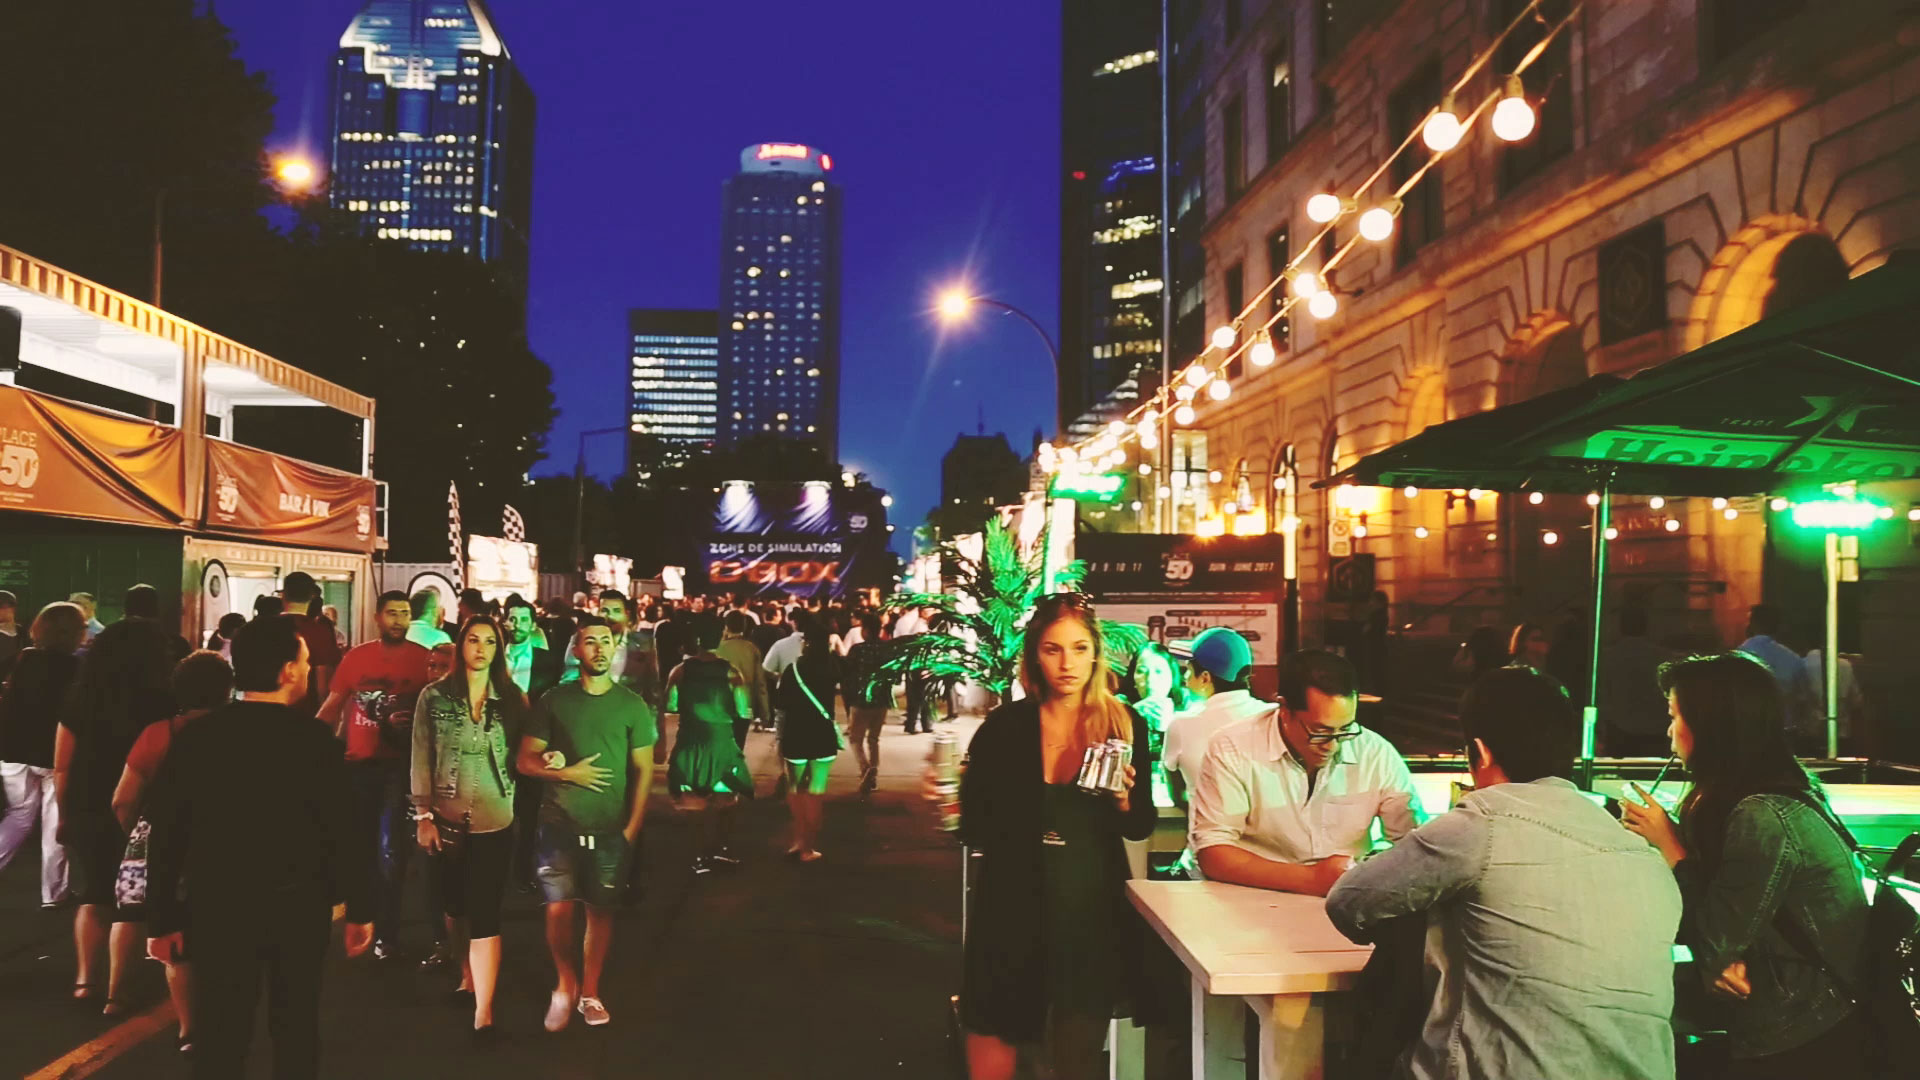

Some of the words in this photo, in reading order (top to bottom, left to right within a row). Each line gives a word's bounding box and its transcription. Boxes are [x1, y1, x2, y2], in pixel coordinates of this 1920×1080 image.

[0, 427, 38, 448] LACE
[279, 493, 303, 513] BAR
[709, 543, 744, 554] ZONE
[748, 543, 763, 553] DE
[768, 543, 842, 553] SIMULATION
